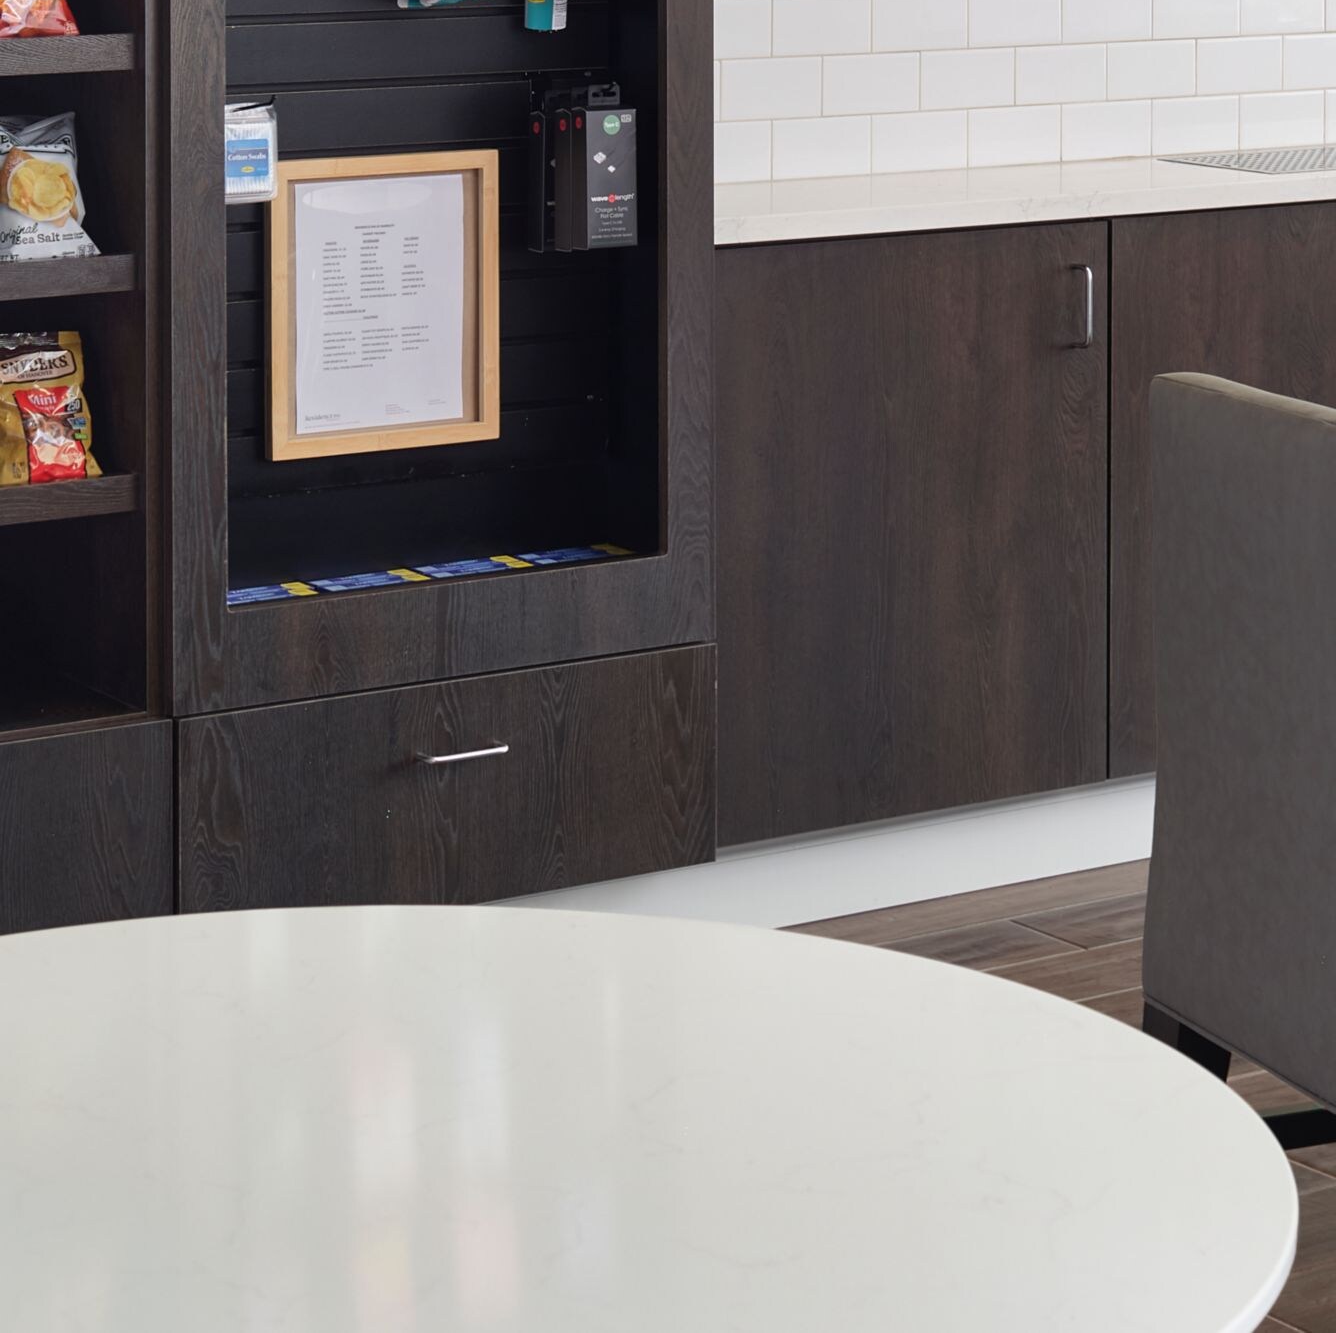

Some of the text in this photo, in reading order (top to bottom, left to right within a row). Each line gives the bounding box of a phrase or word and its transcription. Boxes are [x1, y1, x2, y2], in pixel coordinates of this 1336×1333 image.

[16, 236, 35, 244] Sea
[37, 232, 60, 243] Salt
[28, 393, 57, 406] Mini
[67, 400, 81, 412] 250
